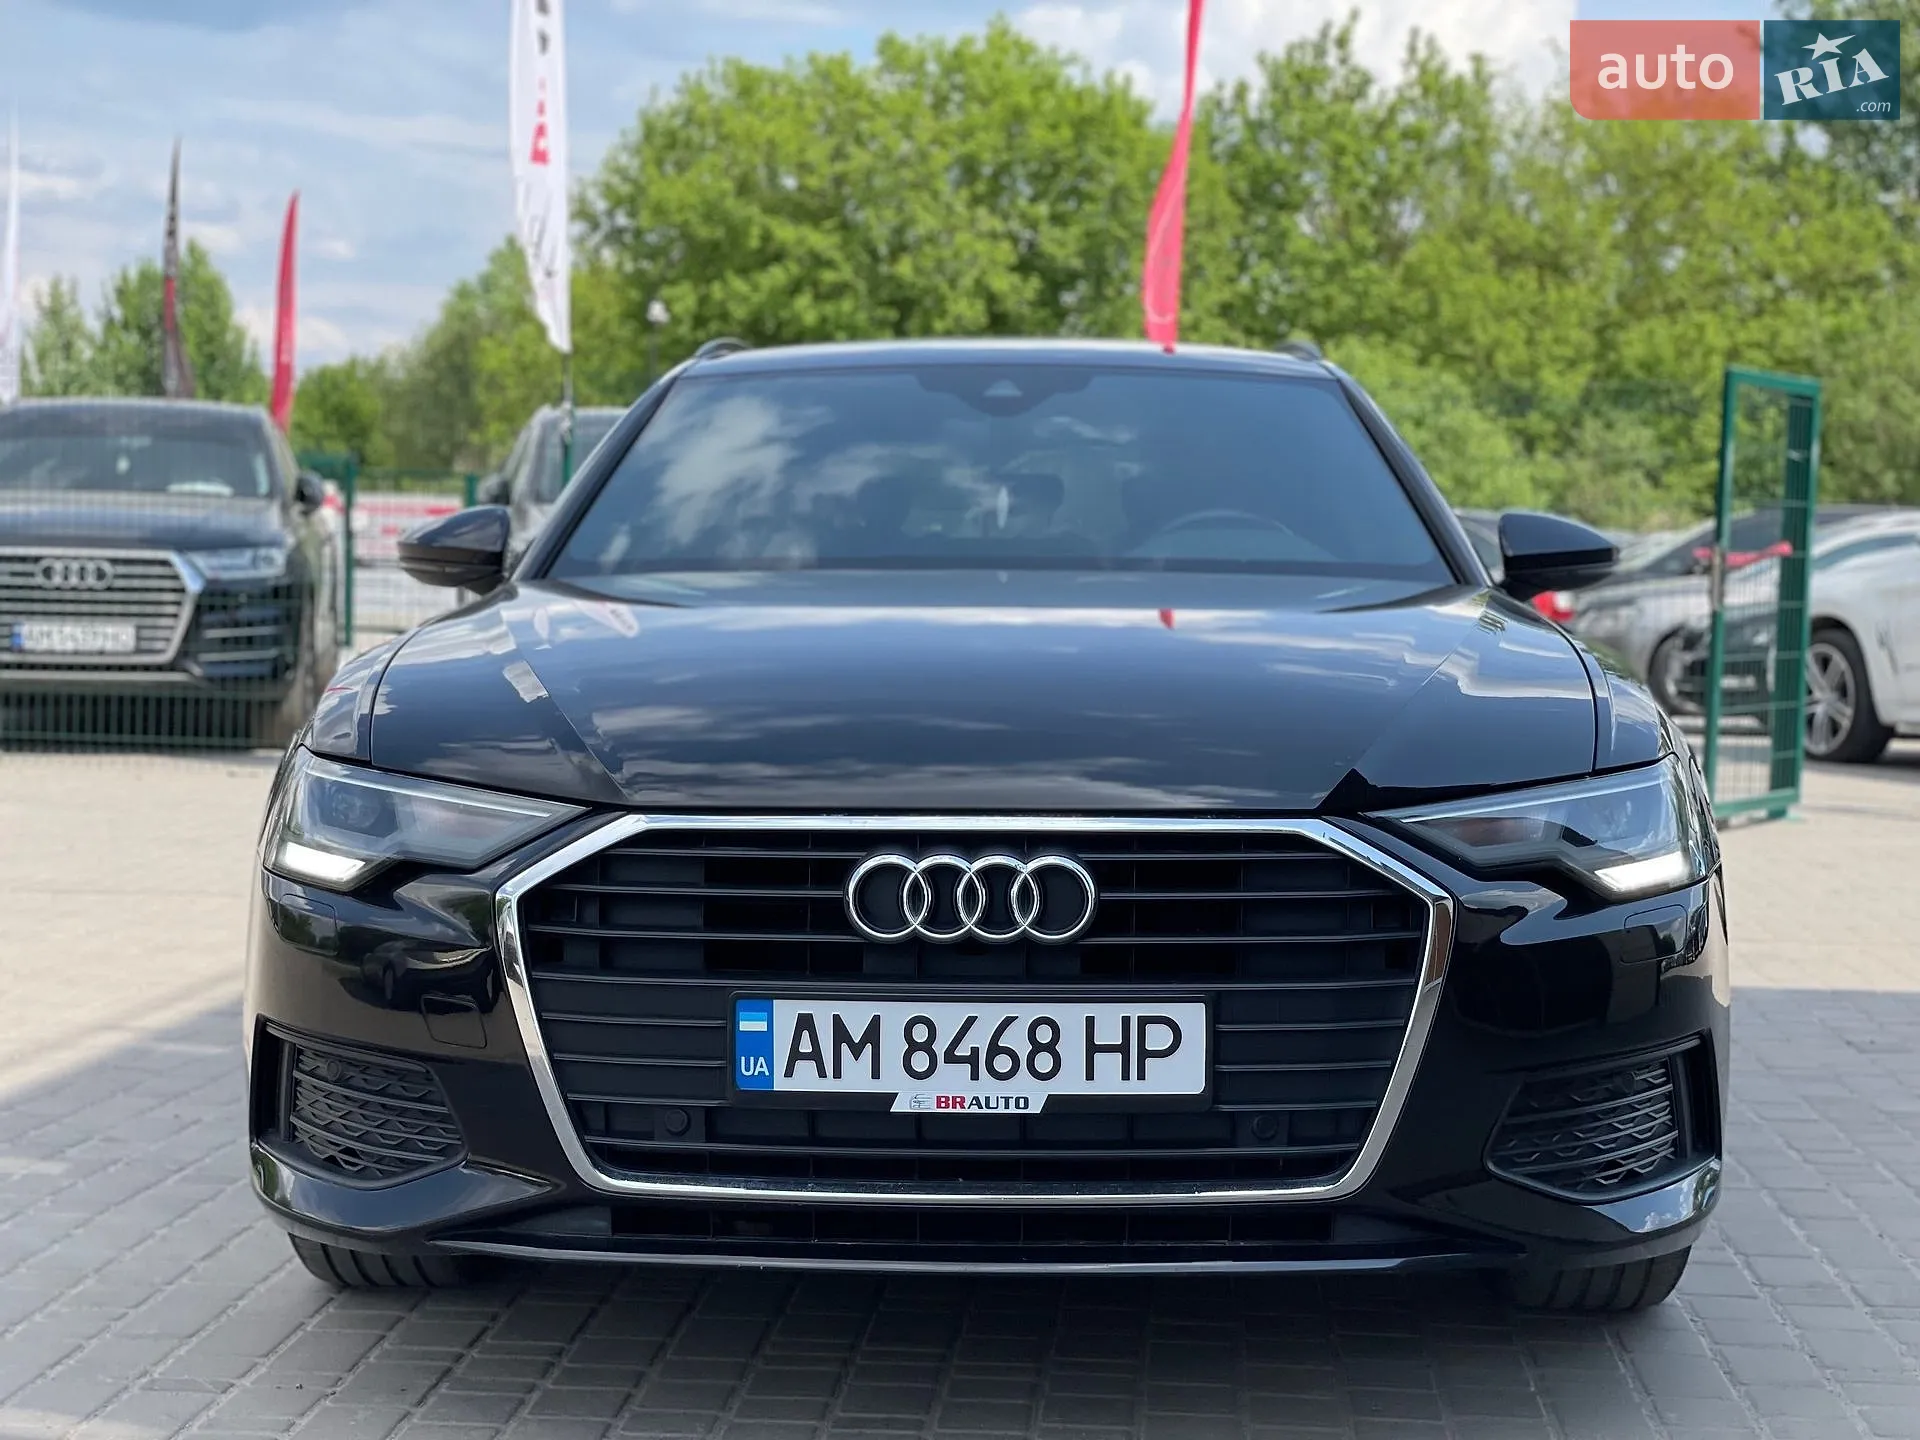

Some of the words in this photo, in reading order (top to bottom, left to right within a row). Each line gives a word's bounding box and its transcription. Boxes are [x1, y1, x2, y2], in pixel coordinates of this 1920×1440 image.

[783, 1012, 881, 1080] AM
[902, 1014, 1062, 1081] 8468
[1085, 1014, 1182, 1082] HP
[740, 1056, 769, 1076] UA
[935, 1095, 1030, 1110] BRAUTO
